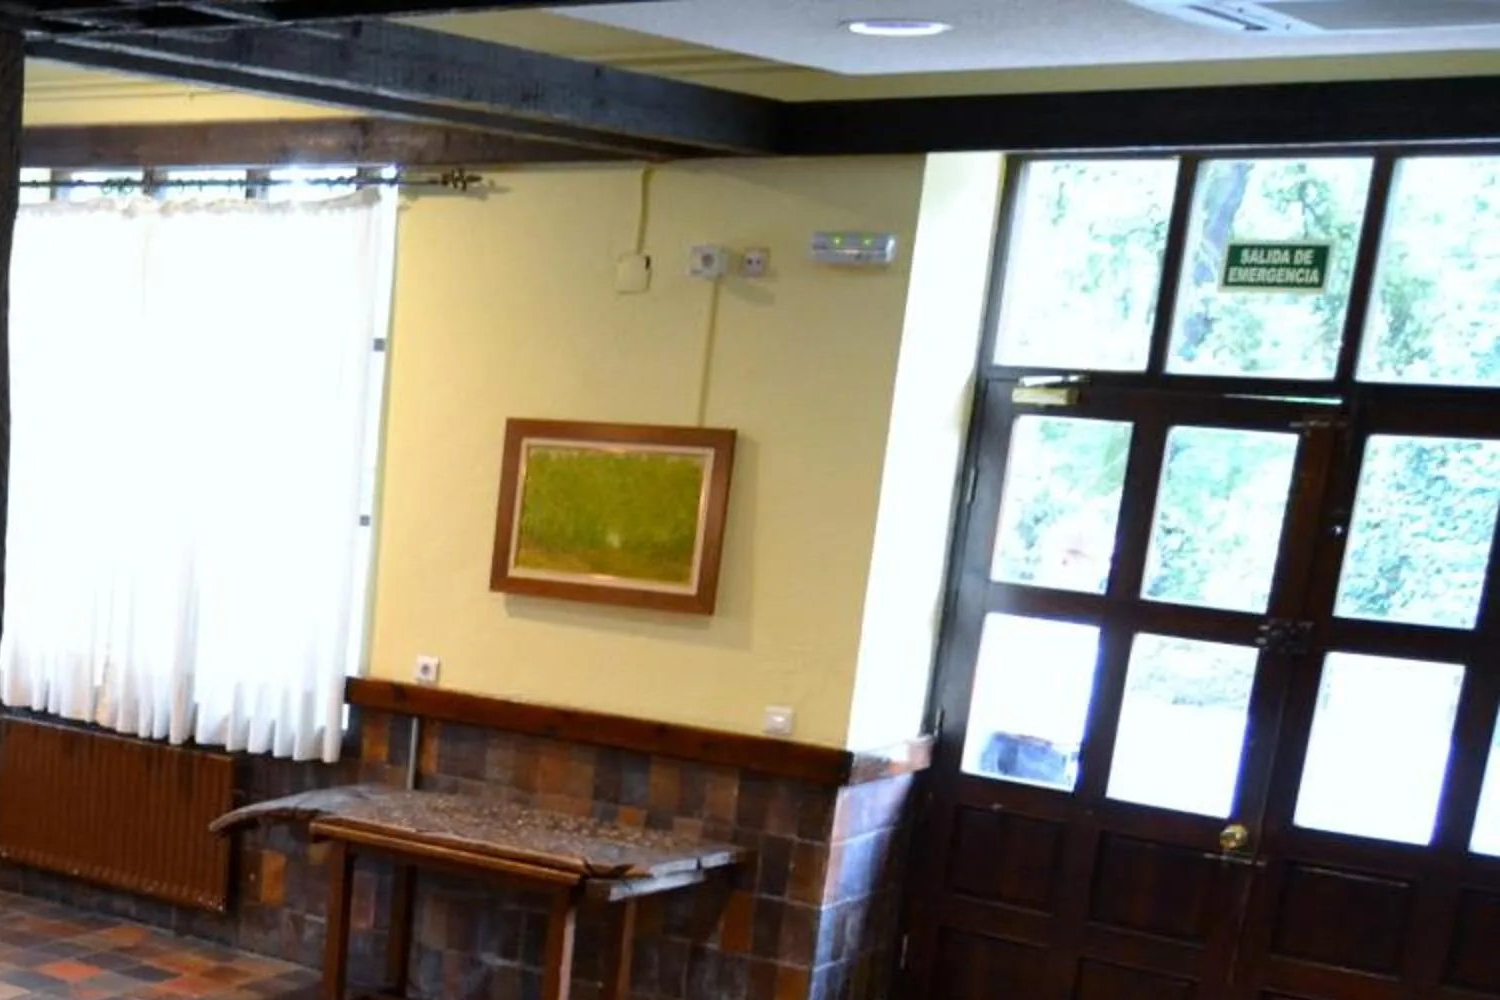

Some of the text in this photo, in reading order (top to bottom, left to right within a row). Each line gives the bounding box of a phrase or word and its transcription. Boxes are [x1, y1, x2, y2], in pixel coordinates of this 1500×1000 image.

[1240, 248, 1314, 265] SALIDA DE
[1227, 266, 1319, 283] EMERGENCIA
